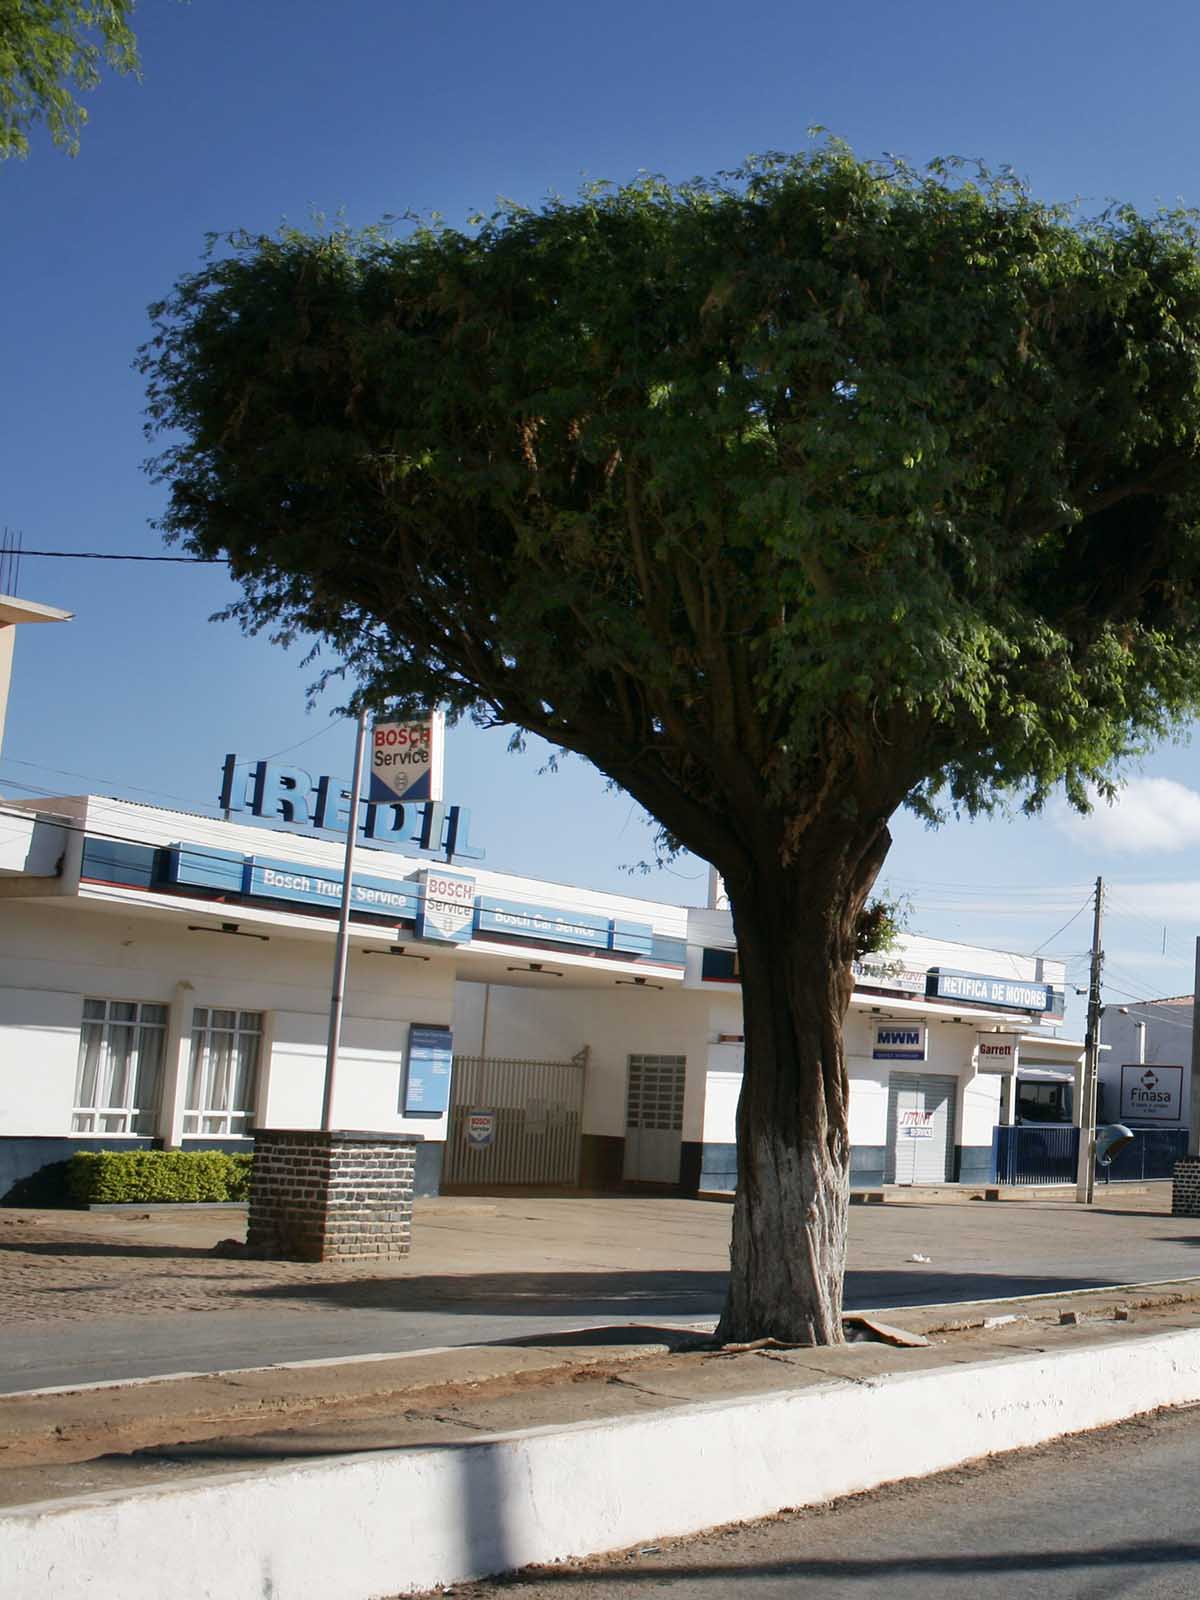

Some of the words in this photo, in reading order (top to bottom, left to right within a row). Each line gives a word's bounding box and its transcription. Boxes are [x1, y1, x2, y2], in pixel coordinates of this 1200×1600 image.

[374, 750, 429, 767] Service
[263, 869, 310, 892] Bosch
[316, 879, 345, 898] Truc
[356, 887, 408, 907] Service
[428, 879, 473, 899] BOSCH
[427, 898, 471, 916] Service
[494, 908, 530, 928] Bosch
[555, 918, 596, 937] Service
[992, 984, 1005, 1001] DE
[1006, 985, 1047, 1007] MOTORES
[878, 1032, 920, 1044] MWM
[980, 1043, 1012, 1055] Garrett
[1131, 1088, 1171, 1103] Finasa
